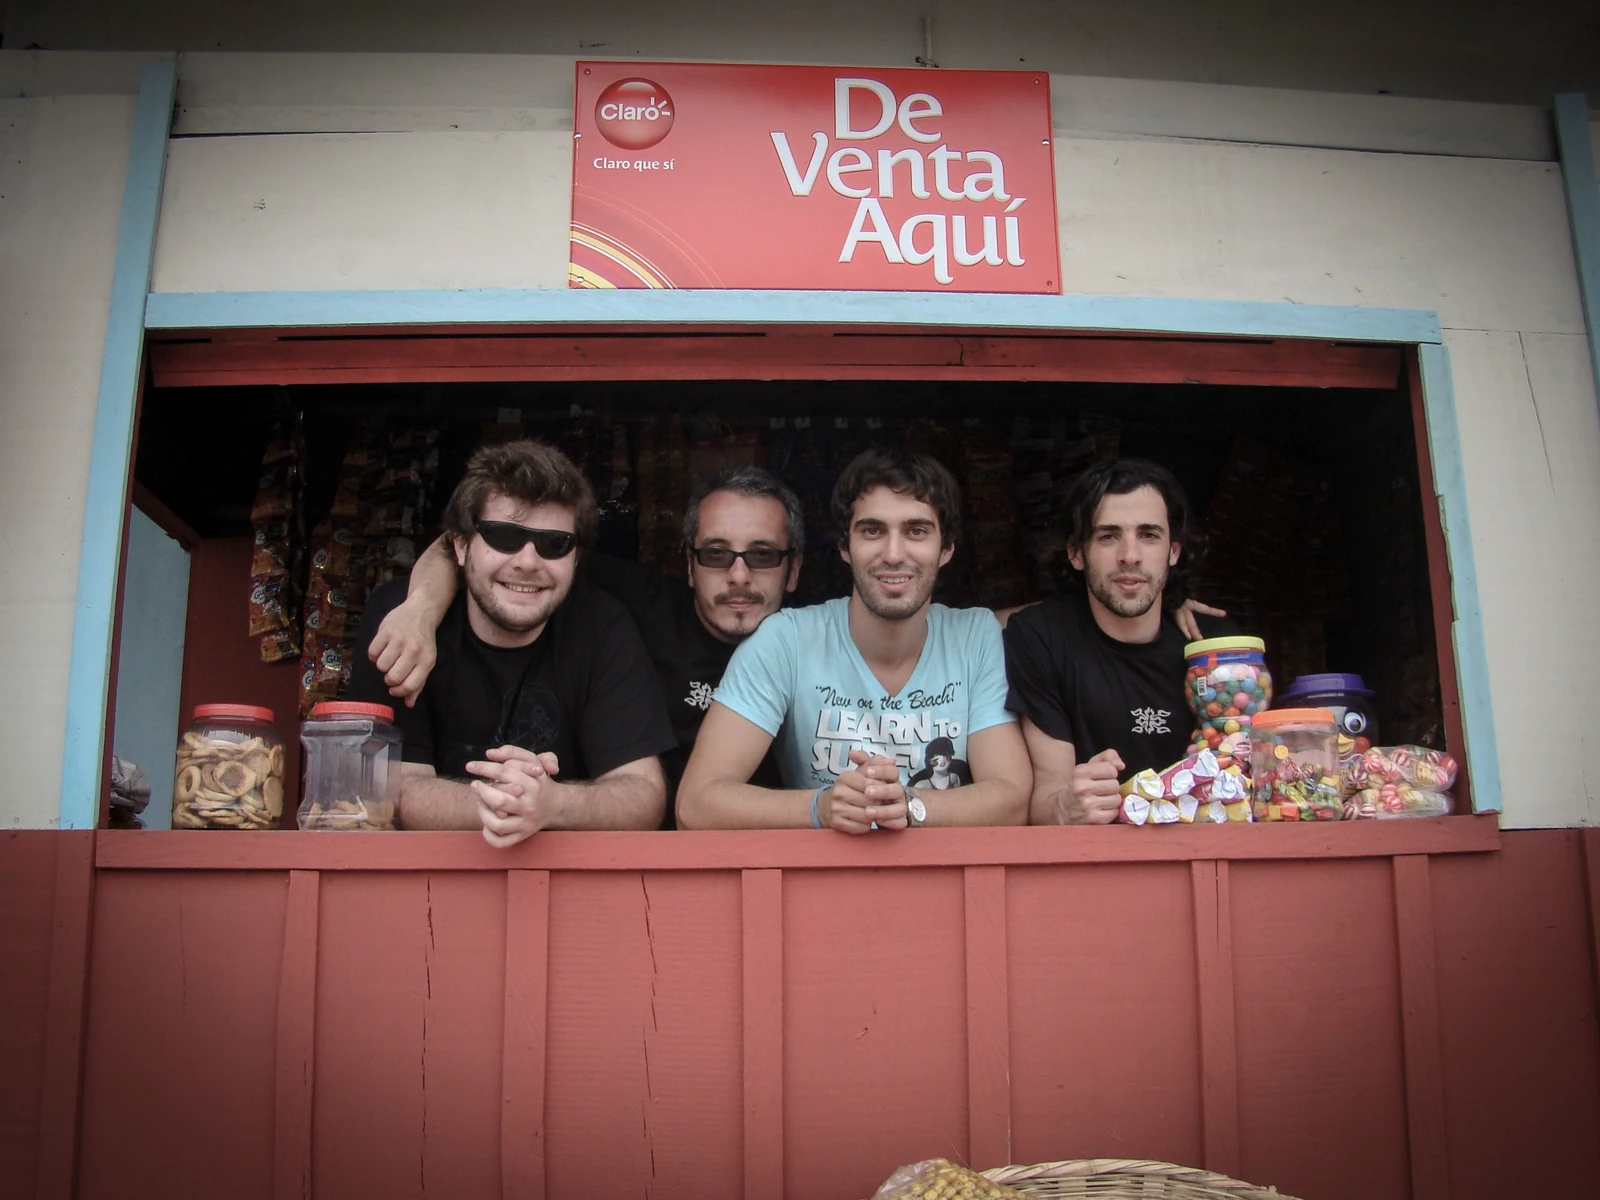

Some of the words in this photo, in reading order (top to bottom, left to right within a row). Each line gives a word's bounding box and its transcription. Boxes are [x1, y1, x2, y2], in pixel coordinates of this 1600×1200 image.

[601, 102, 661, 120] Claro
[835, 77, 944, 143] De
[593, 157, 631, 169] Claro
[633, 160, 660, 172] que
[663, 158, 675, 170] sí
[769, 130, 1012, 201] Venta
[838, 197, 1026, 285] Aquí
[857, 697, 874, 710] on
[880, 696, 903, 710] the
[815, 709, 931, 745] LEARN
